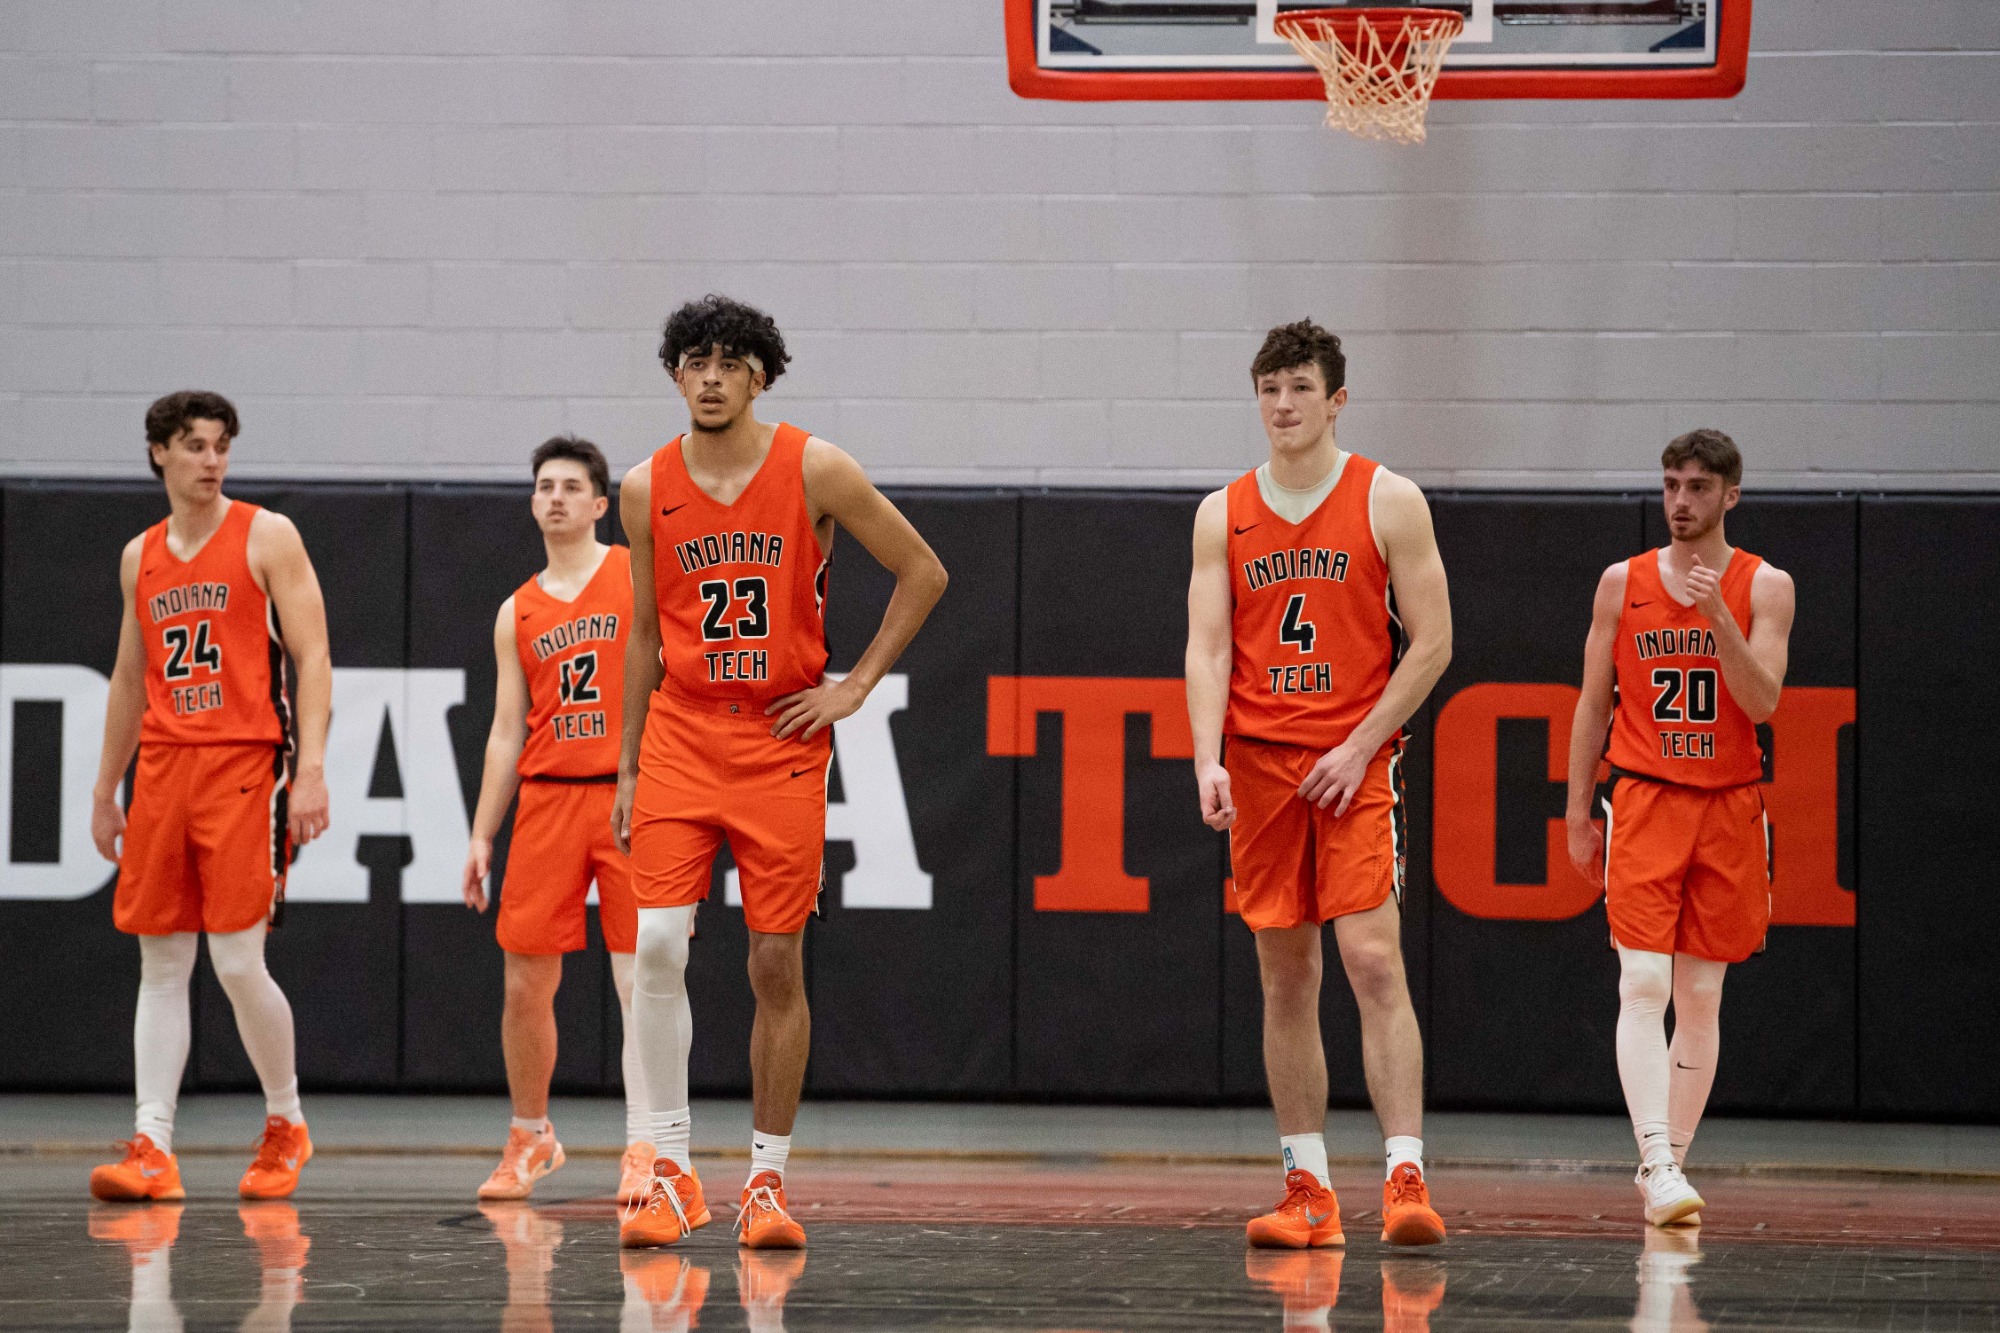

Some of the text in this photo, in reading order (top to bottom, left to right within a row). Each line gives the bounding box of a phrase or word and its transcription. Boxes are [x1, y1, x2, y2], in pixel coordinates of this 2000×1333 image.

[675, 532, 784, 574] INDIANA
[1243, 547, 1350, 591] INDIANA
[148, 581, 229, 625] INDIANA
[699, 576, 769, 642] 23
[1279, 593, 1316, 654] 4
[163, 619, 221, 681] 24
[531, 613, 619, 663] INDIANA
[1634, 628, 1719, 661] INDIAN
[558, 649, 600, 707] 12
[704, 649, 768, 682] TECH
[1268, 662, 1332, 694] TECH
[172, 681, 224, 715] TECH
[1651, 667, 1718, 724] 20
[550, 712, 606, 741] TECH
[1659, 730, 1715, 759] TECH
[987, 675, 1857, 927] TCH
